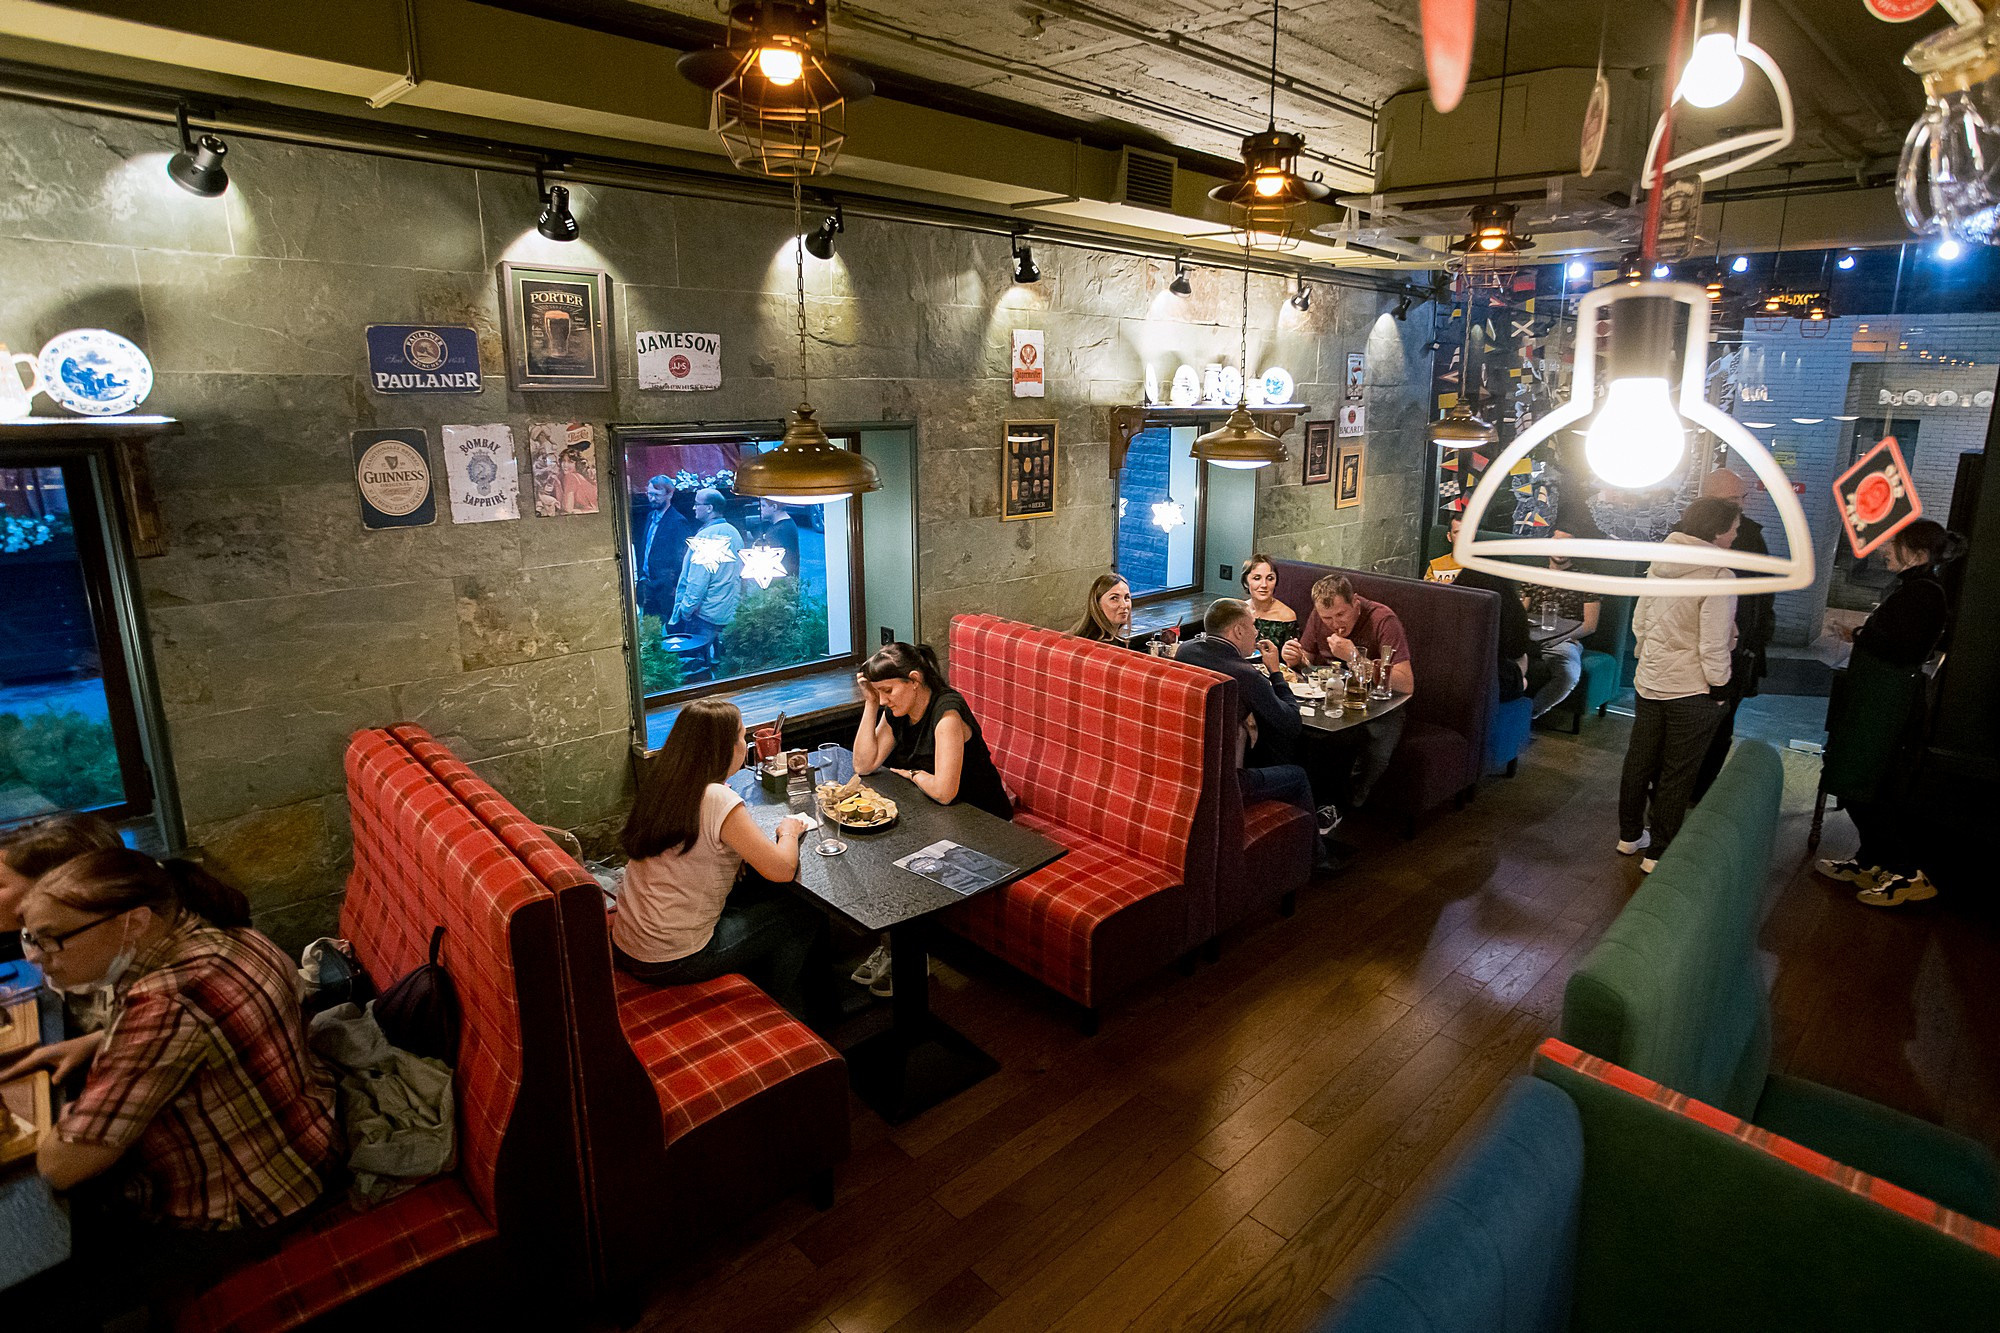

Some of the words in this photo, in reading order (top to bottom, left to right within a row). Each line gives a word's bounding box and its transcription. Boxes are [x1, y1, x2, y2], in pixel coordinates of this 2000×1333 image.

[530, 292, 584, 307] PORTER
[406, 332, 444, 347] PAULANER
[638, 333, 717, 355] JAMESON
[375, 372, 482, 389] PAULANER
[1339, 425, 1364, 435] BACARDI
[459, 438, 502, 456] BOMBAY
[363, 470, 425, 485] GUINNESS
[462, 489, 508, 507] SAPPHIRE
